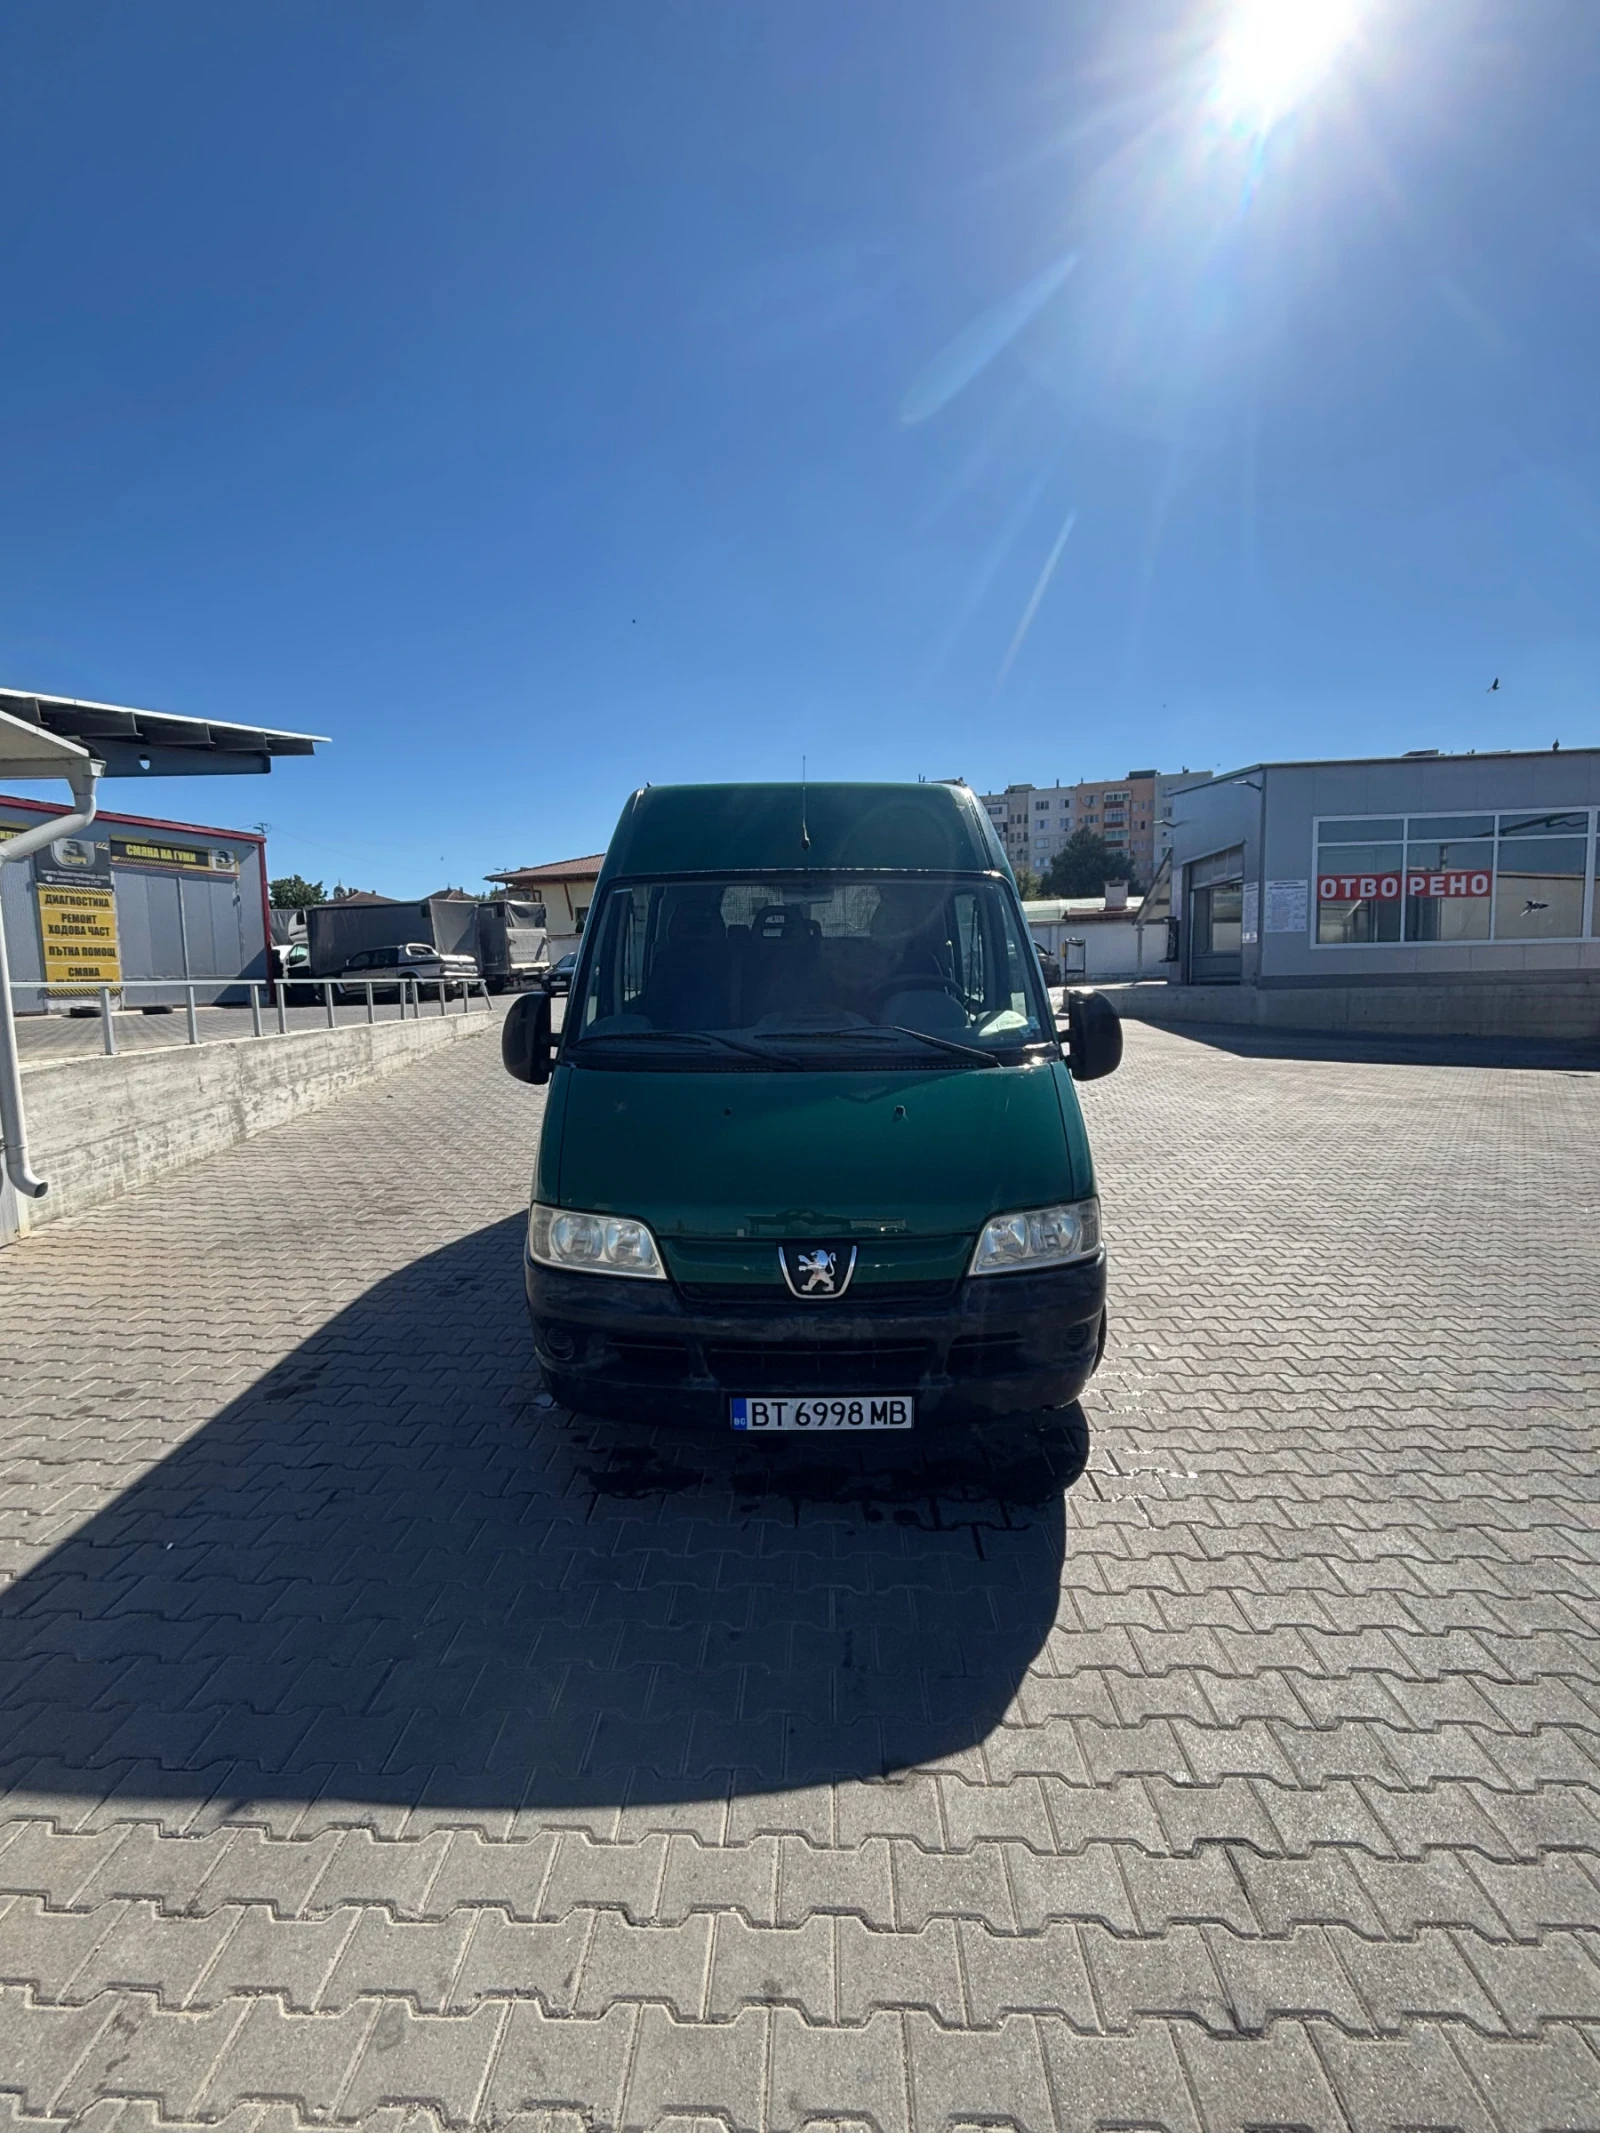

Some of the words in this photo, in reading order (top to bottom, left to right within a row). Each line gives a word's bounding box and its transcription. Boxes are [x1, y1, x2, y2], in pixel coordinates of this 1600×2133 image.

[126, 844, 159, 858] СМЯНА
[160, 848, 172, 859] НА
[173, 850, 196, 862] ГУМИ
[1320, 874, 1489, 899] ОТВОРЕНО
[45, 894, 110, 907] ДИАГНОСТИКА
[61, 913, 97, 924] РЕМОНТ
[48, 924, 86, 936] ХОДОВА
[88, 926, 110, 936] ЧАСТ
[48, 946, 80, 956] ПЪТНА
[82, 947, 116, 958] ПОМОЩ
[68, 967, 100, 977] СМЯНА
[751, 1402, 788, 1427] BT
[795, 1401, 864, 1426] 6998
[870, 1400, 907, 1426] MB
[733, 1417, 746, 1426] BG
